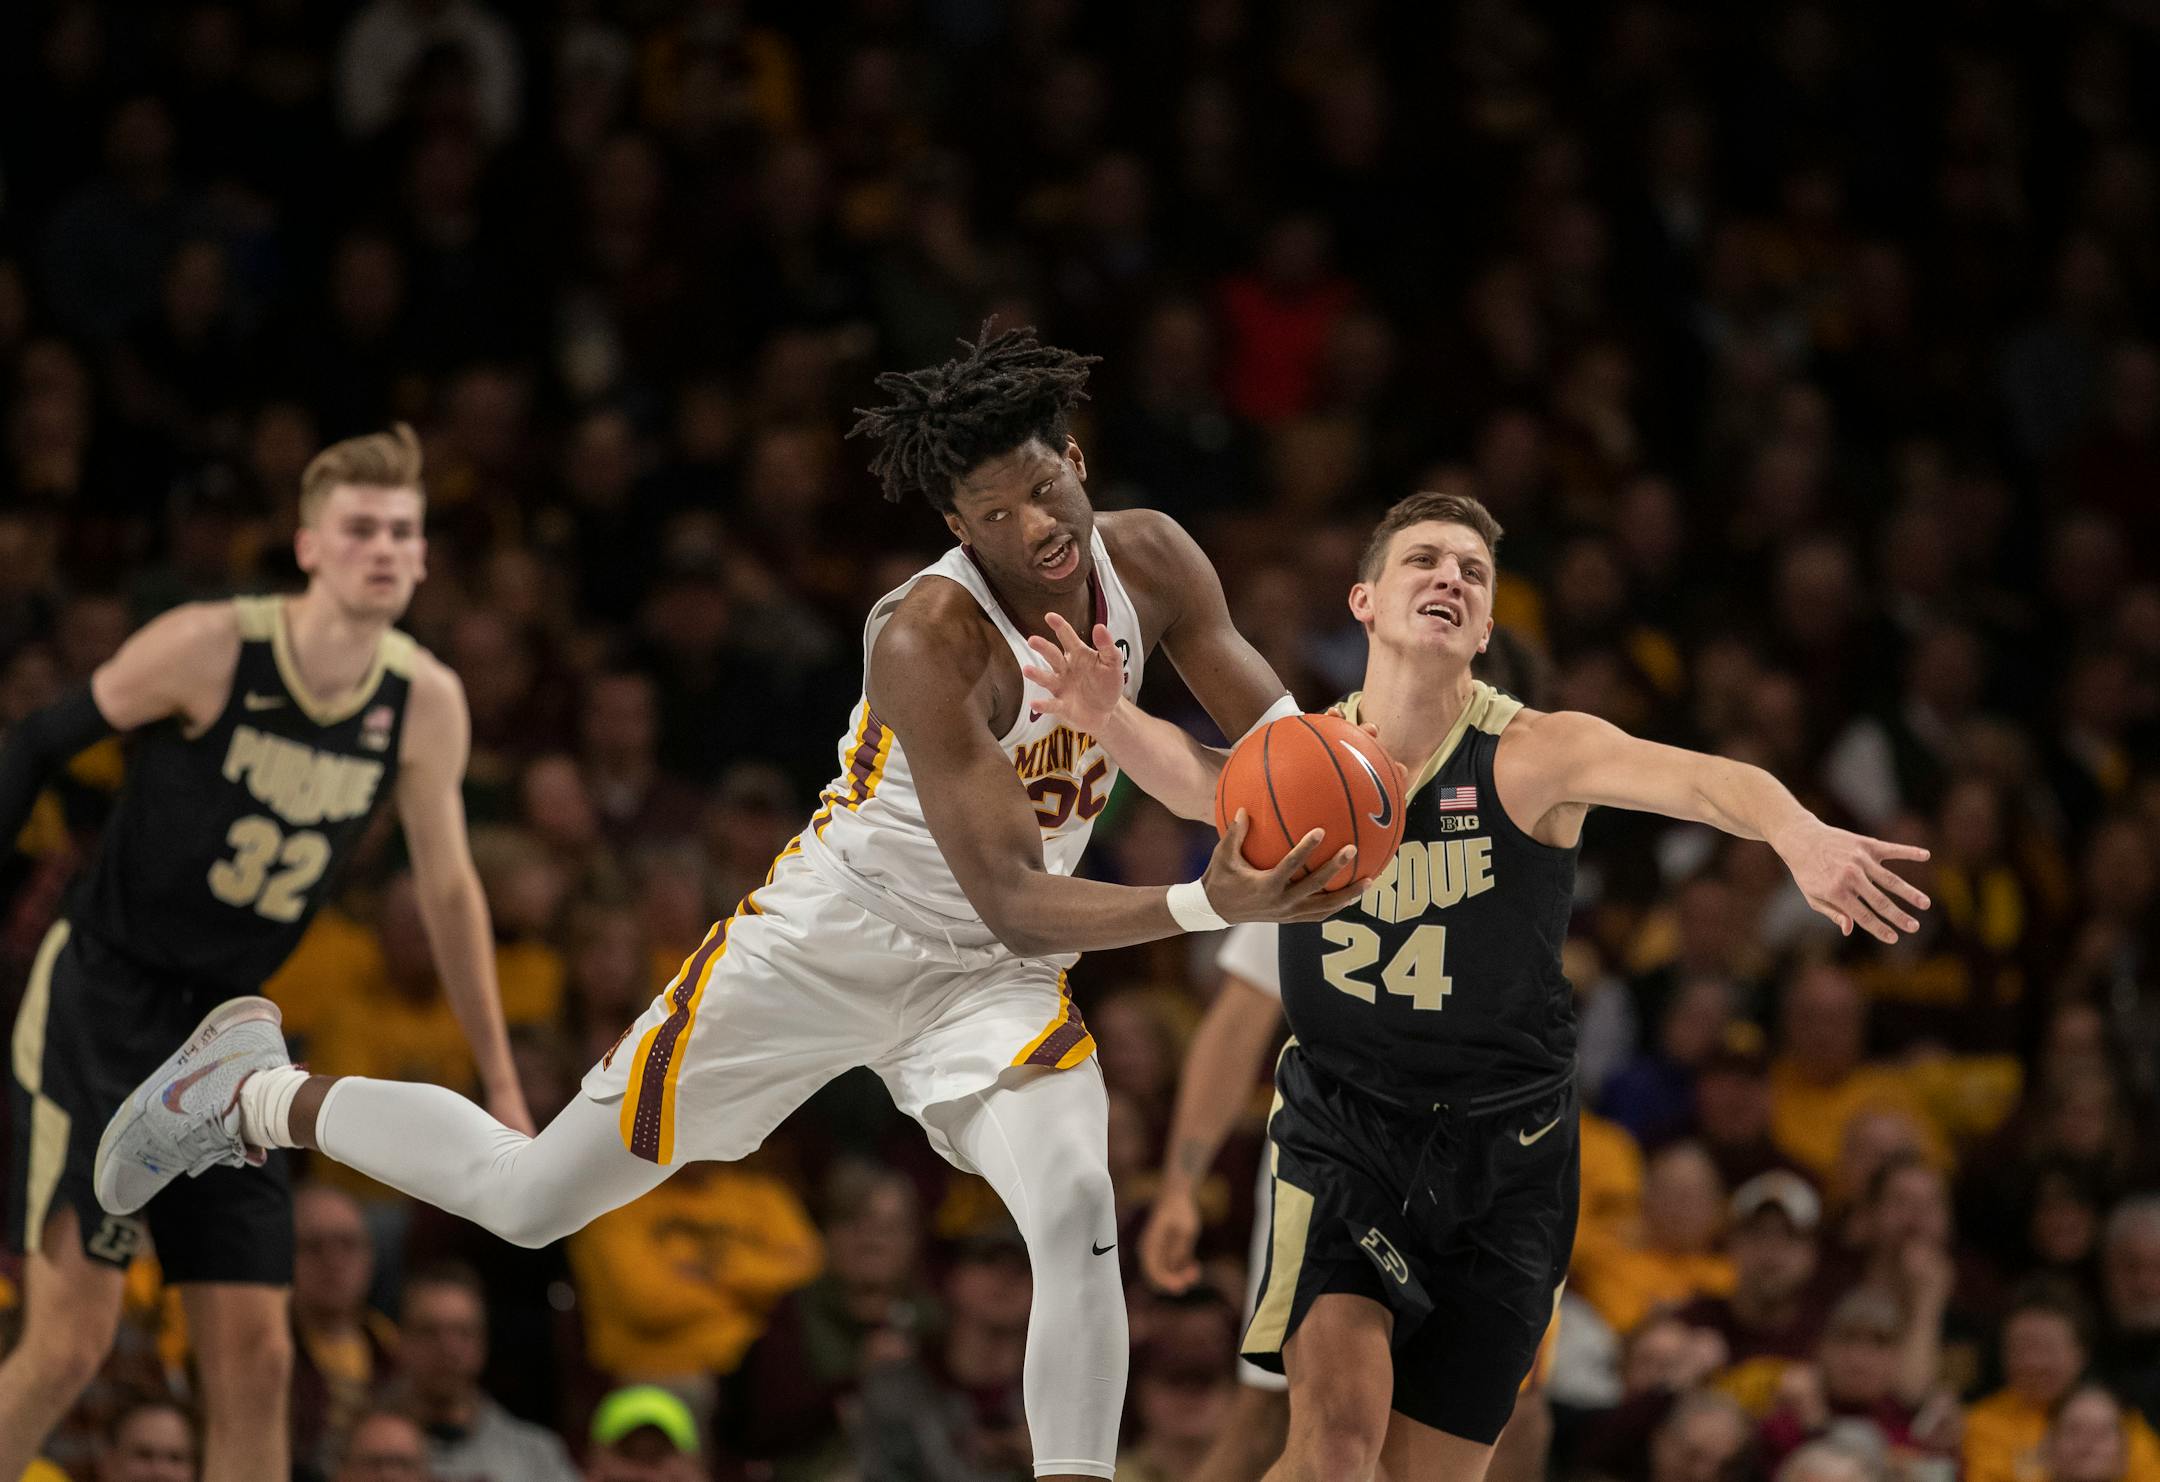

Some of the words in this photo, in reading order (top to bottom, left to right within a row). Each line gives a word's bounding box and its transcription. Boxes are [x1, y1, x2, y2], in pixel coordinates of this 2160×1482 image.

[206, 814, 333, 923] 32
[1352, 836, 1495, 924] RDUE
[1321, 919, 1453, 1011] 24
